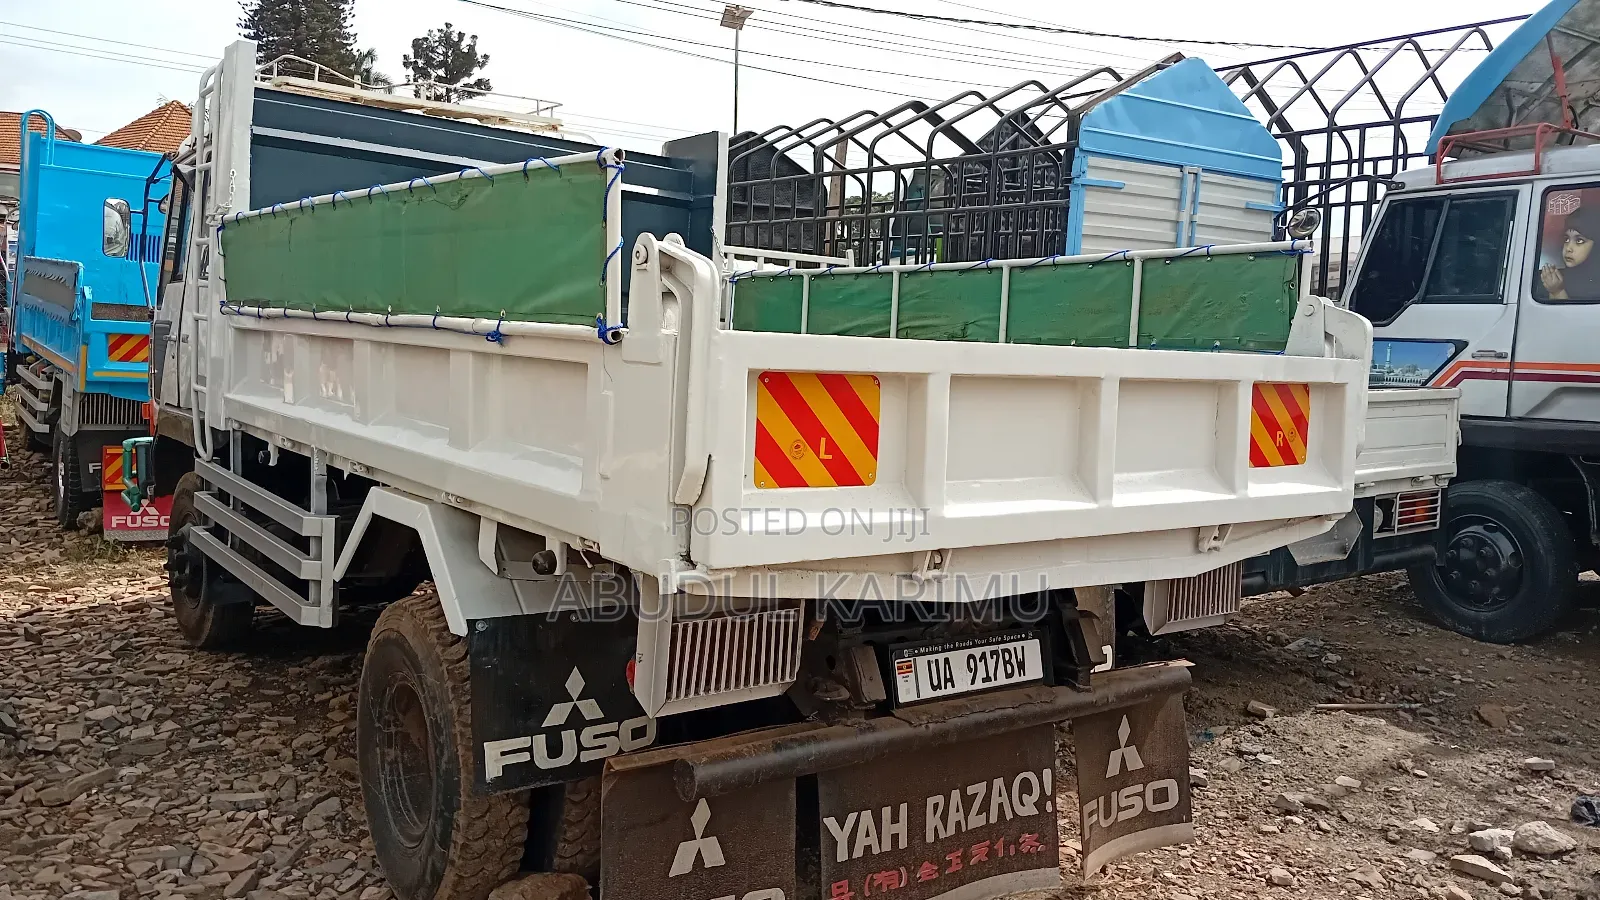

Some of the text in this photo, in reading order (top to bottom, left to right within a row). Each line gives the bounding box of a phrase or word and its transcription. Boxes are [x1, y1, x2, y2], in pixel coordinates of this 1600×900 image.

[819, 437, 833, 460] L
[1276, 431, 1284, 447] R
[920, 645, 942, 654] Making
[944, 642, 954, 650] the
[955, 640, 973, 648] Roads
[974, 637, 988, 645] Your
[989, 635, 1002, 643] Safe
[1003, 633, 1021, 641] Space
[927, 645, 1026, 692] UA 917BW
[483, 715, 657, 783] FUSO
[823, 768, 1053, 863] YAH RAZAQ!
[1082, 778, 1179, 841] FUSO
